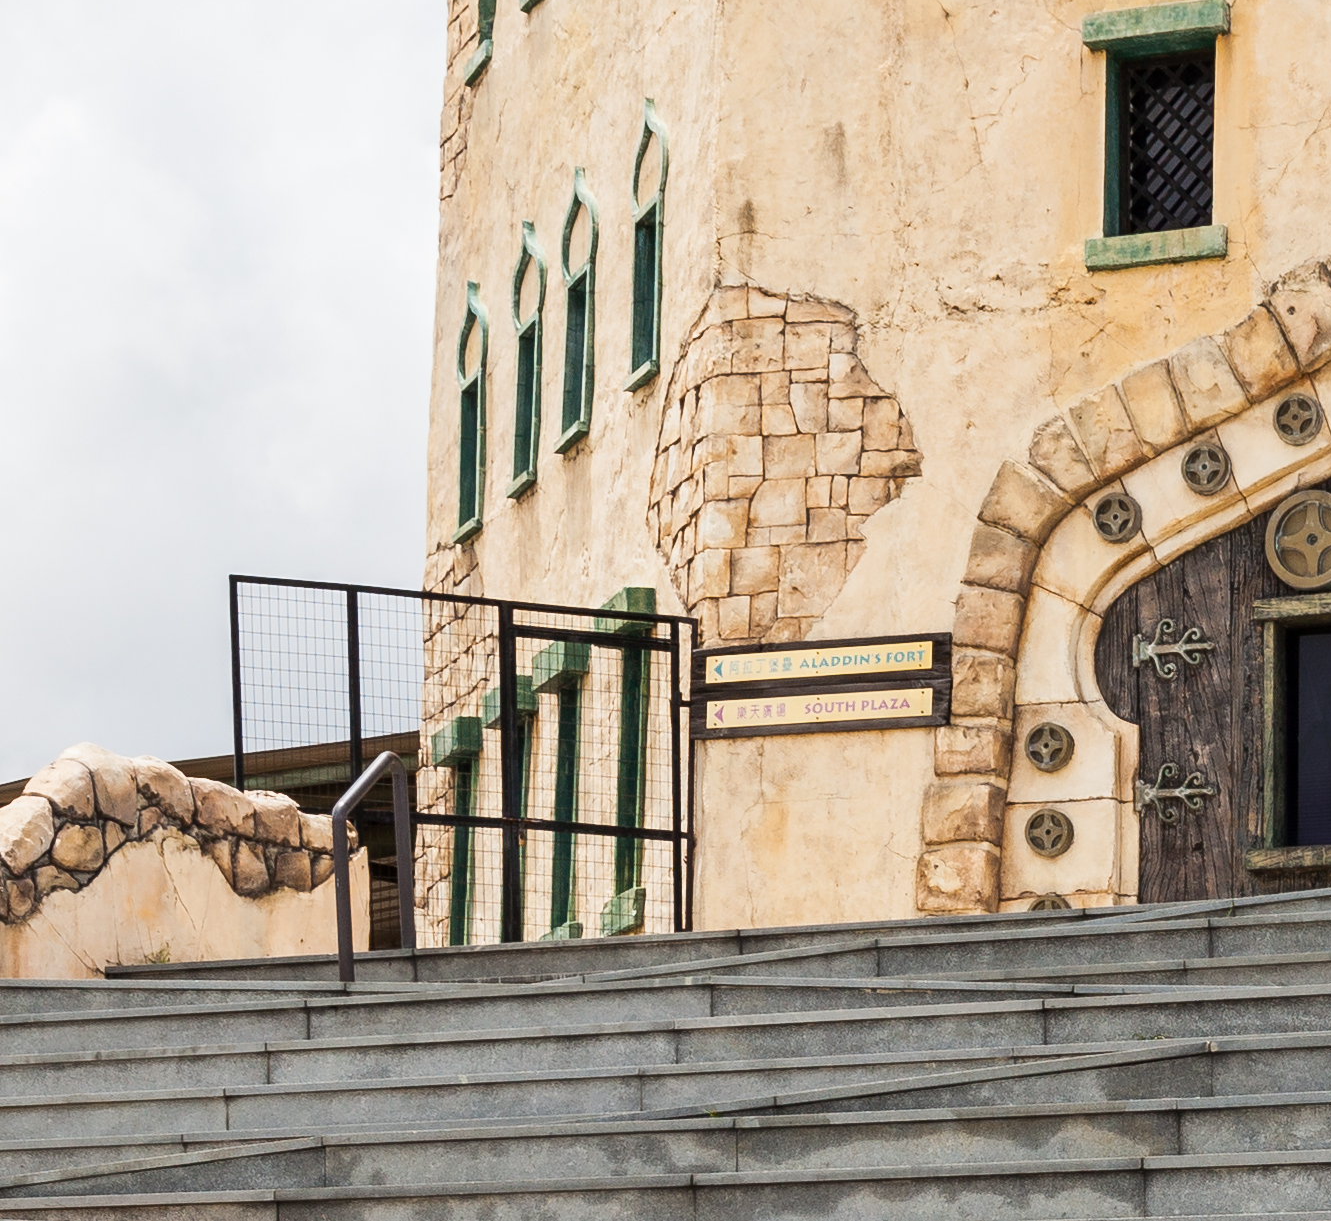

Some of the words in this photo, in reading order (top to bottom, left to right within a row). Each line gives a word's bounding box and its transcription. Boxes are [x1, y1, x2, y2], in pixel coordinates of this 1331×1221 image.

[799, 653, 882, 669] ALADDIN'S
[886, 650, 926, 663] FORT
[804, 700, 856, 715] SOUTH
[861, 697, 911, 711] PLAZA
